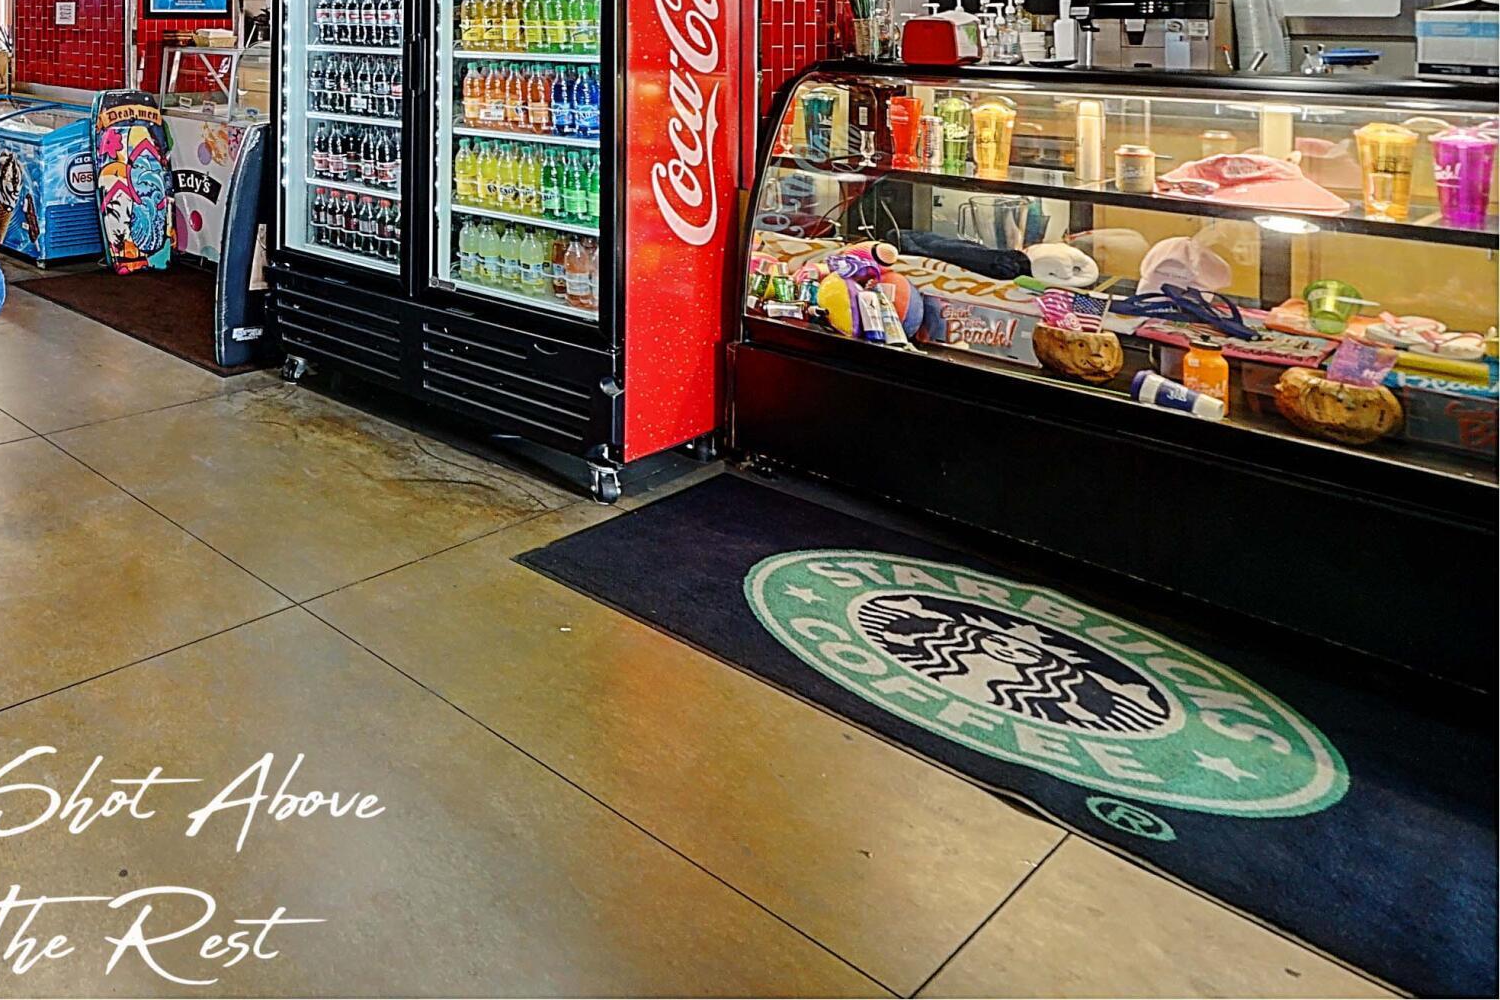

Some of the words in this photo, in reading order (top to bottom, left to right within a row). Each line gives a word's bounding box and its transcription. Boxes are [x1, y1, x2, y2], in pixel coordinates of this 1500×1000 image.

[106, 108, 134, 122] Dead
[138, 110, 159, 121] men
[72, 171, 94, 183] Nes
[177, 171, 211, 194] Edy's
[946, 318, 1019, 349] Beach!
[806, 561, 1293, 756] STARBUCKS
[790, 617, 1164, 783] COFFEE
